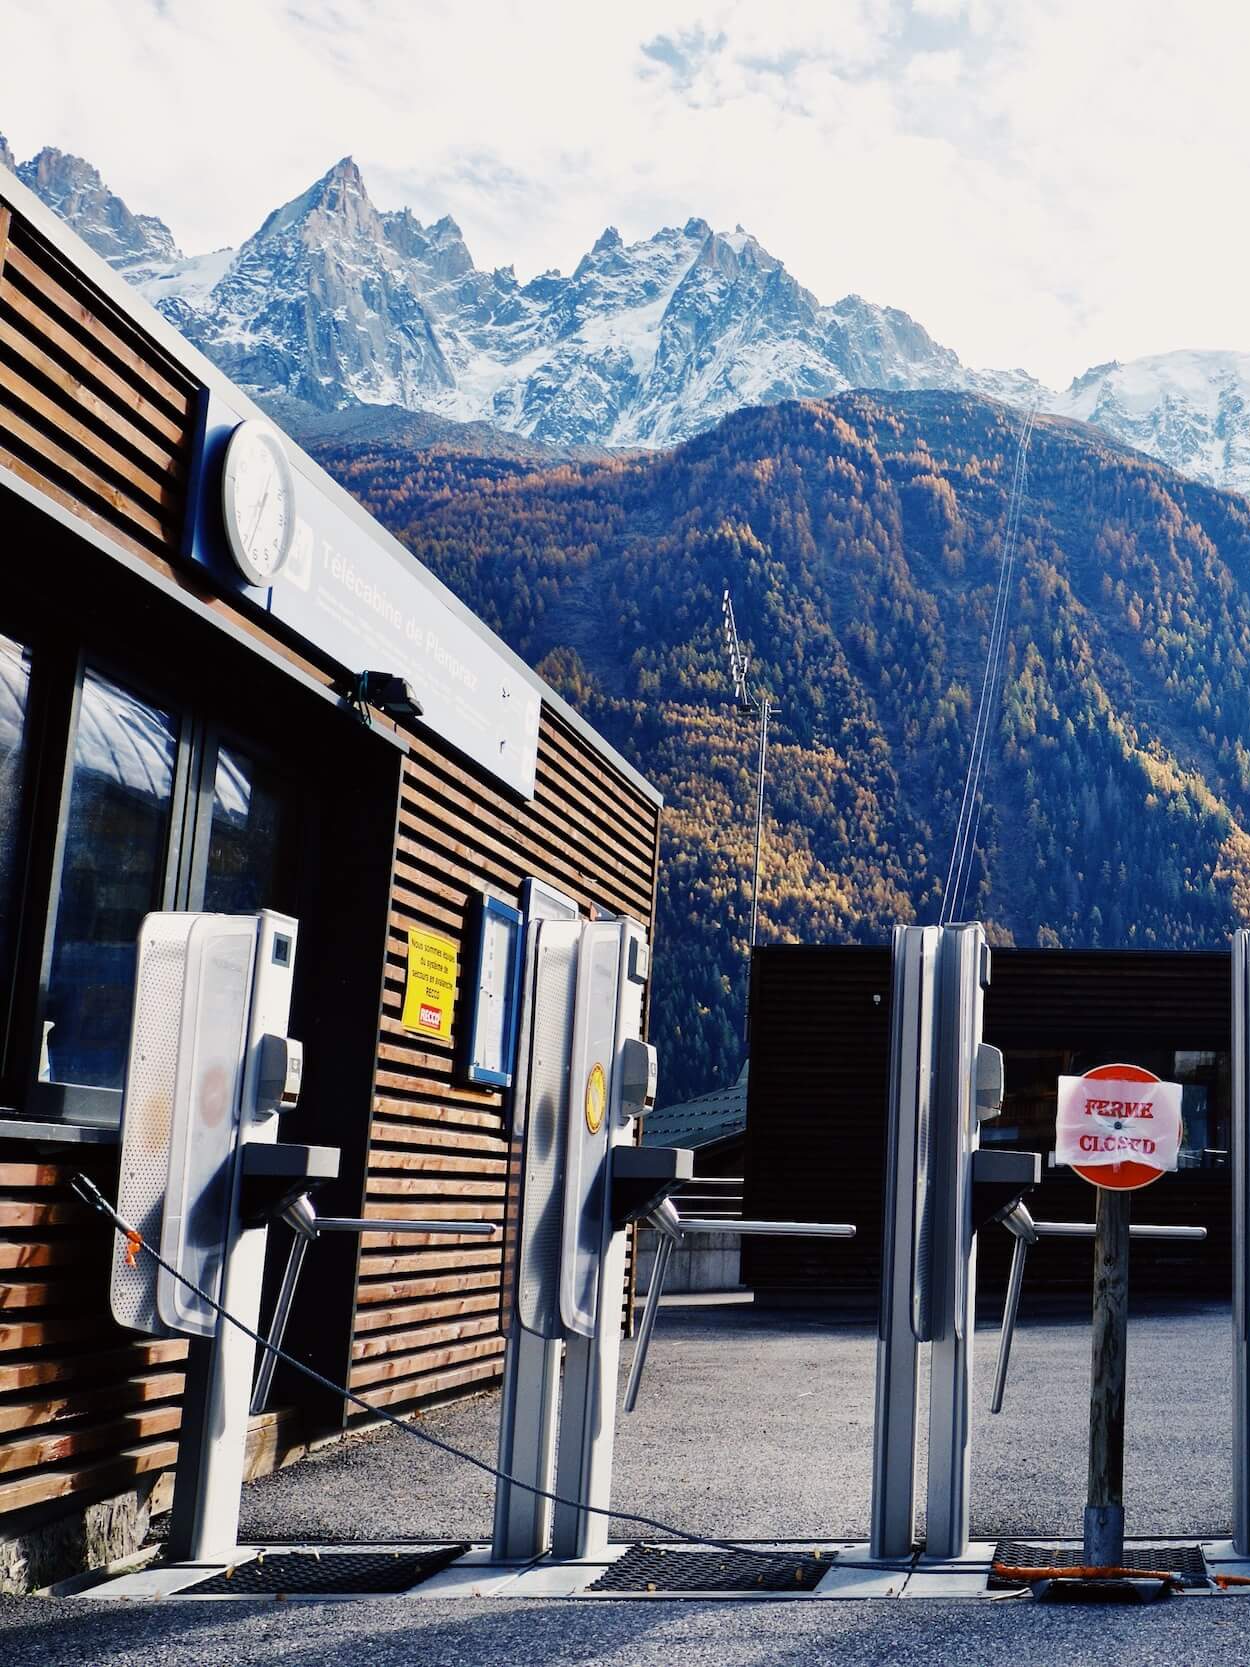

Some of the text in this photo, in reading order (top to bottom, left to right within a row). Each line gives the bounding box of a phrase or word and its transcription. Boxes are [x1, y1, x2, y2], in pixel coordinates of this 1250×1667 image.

[321, 539, 402, 630] Télécabine
[406, 615, 424, 647] de
[425, 630, 480, 692] Planpraz
[420, 1007, 440, 1025] RECCO
[1084, 1099, 1154, 1119] FERME
[1079, 1135, 1156, 1154] CLOSED
